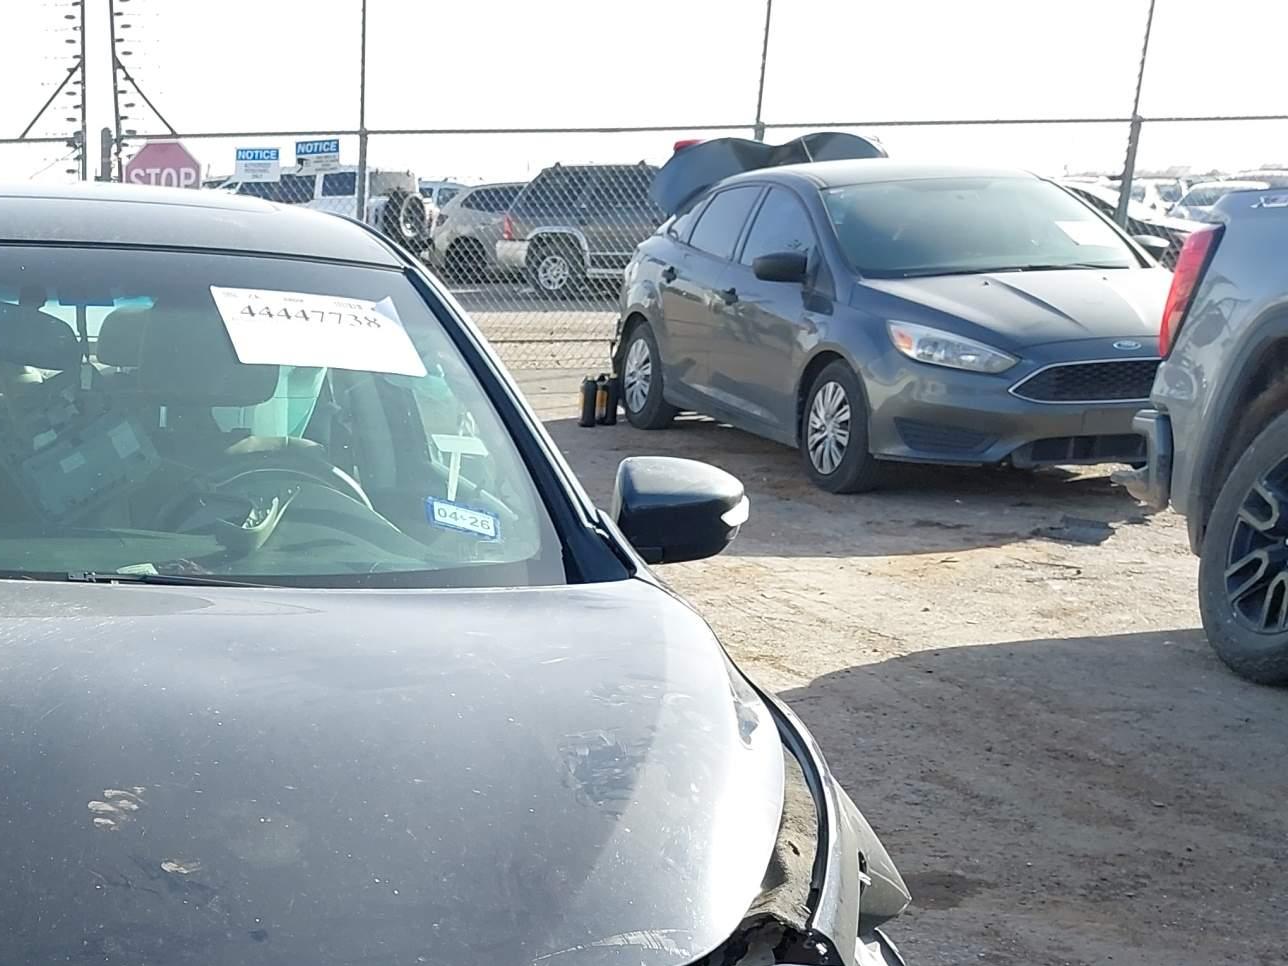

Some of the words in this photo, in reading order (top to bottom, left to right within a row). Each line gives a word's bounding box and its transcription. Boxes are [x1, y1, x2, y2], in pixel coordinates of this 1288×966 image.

[237, 149, 278, 160] NOTICE
[297, 140, 338, 154] NOTICE
[130, 167, 197, 189] STOP
[239, 303, 382, 329] 44447738
[436, 506, 492, 531] 04-26
